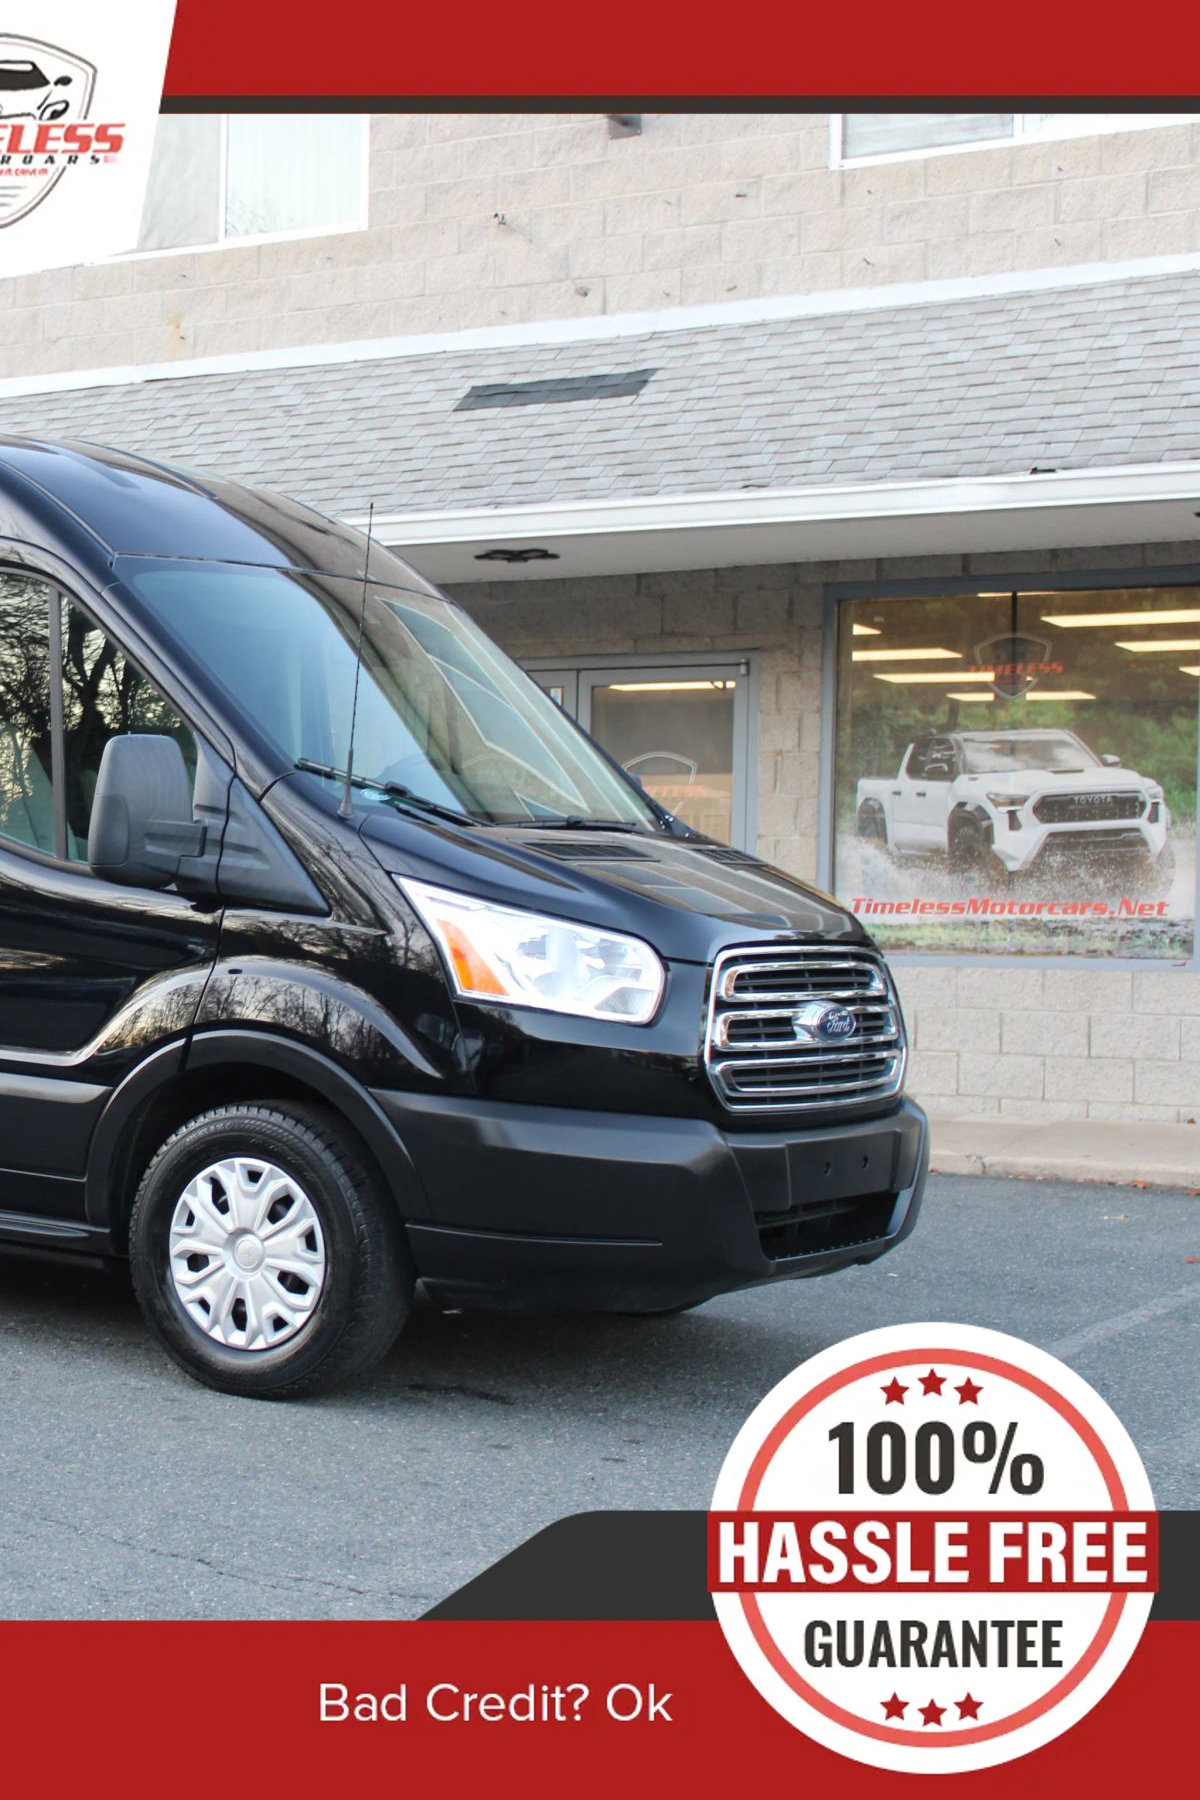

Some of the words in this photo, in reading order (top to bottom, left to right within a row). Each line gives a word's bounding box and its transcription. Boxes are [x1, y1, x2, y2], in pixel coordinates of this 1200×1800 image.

[1073, 795, 1113, 805] TOYOTA
[850, 898, 1170, 916] TimelessMotorcars.Net
[826, 1011, 851, 1032] Ford
